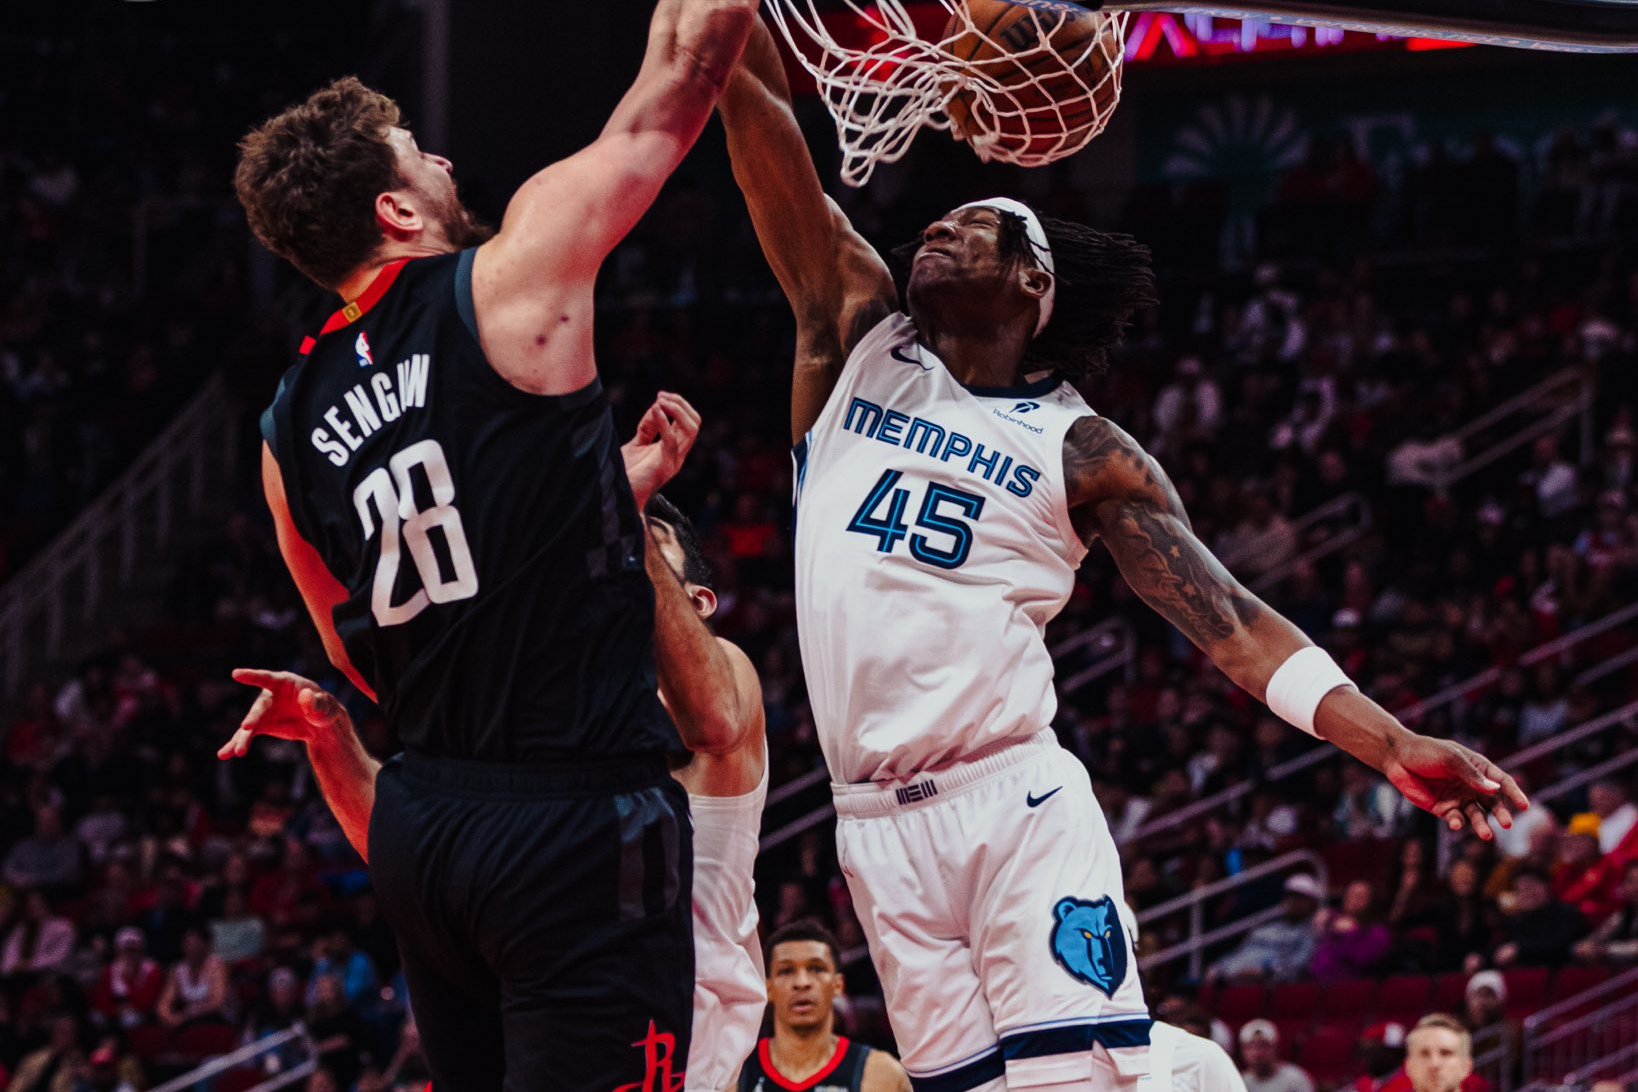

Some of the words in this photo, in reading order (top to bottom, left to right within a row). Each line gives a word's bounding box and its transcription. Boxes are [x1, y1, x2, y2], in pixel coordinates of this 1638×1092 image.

[843, 396, 1041, 498] MEMPHIS
[993, 408, 1044, 434] Robinhood
[353, 438, 478, 627] 28
[845, 468, 986, 570] 45
